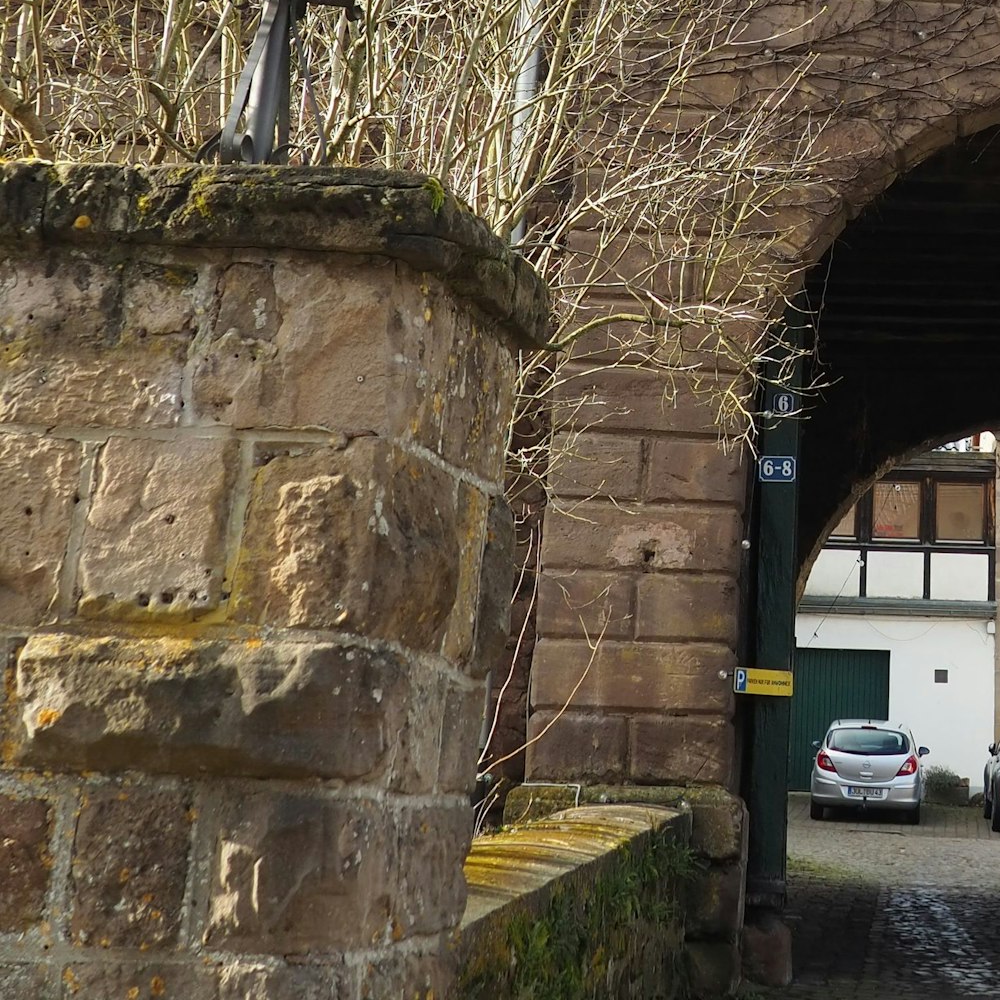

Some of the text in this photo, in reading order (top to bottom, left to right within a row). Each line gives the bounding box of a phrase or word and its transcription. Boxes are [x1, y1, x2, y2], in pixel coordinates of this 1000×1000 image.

[778, 395, 789, 411] 6
[763, 460, 792, 476] 6-8
[736, 670, 745, 690] P
